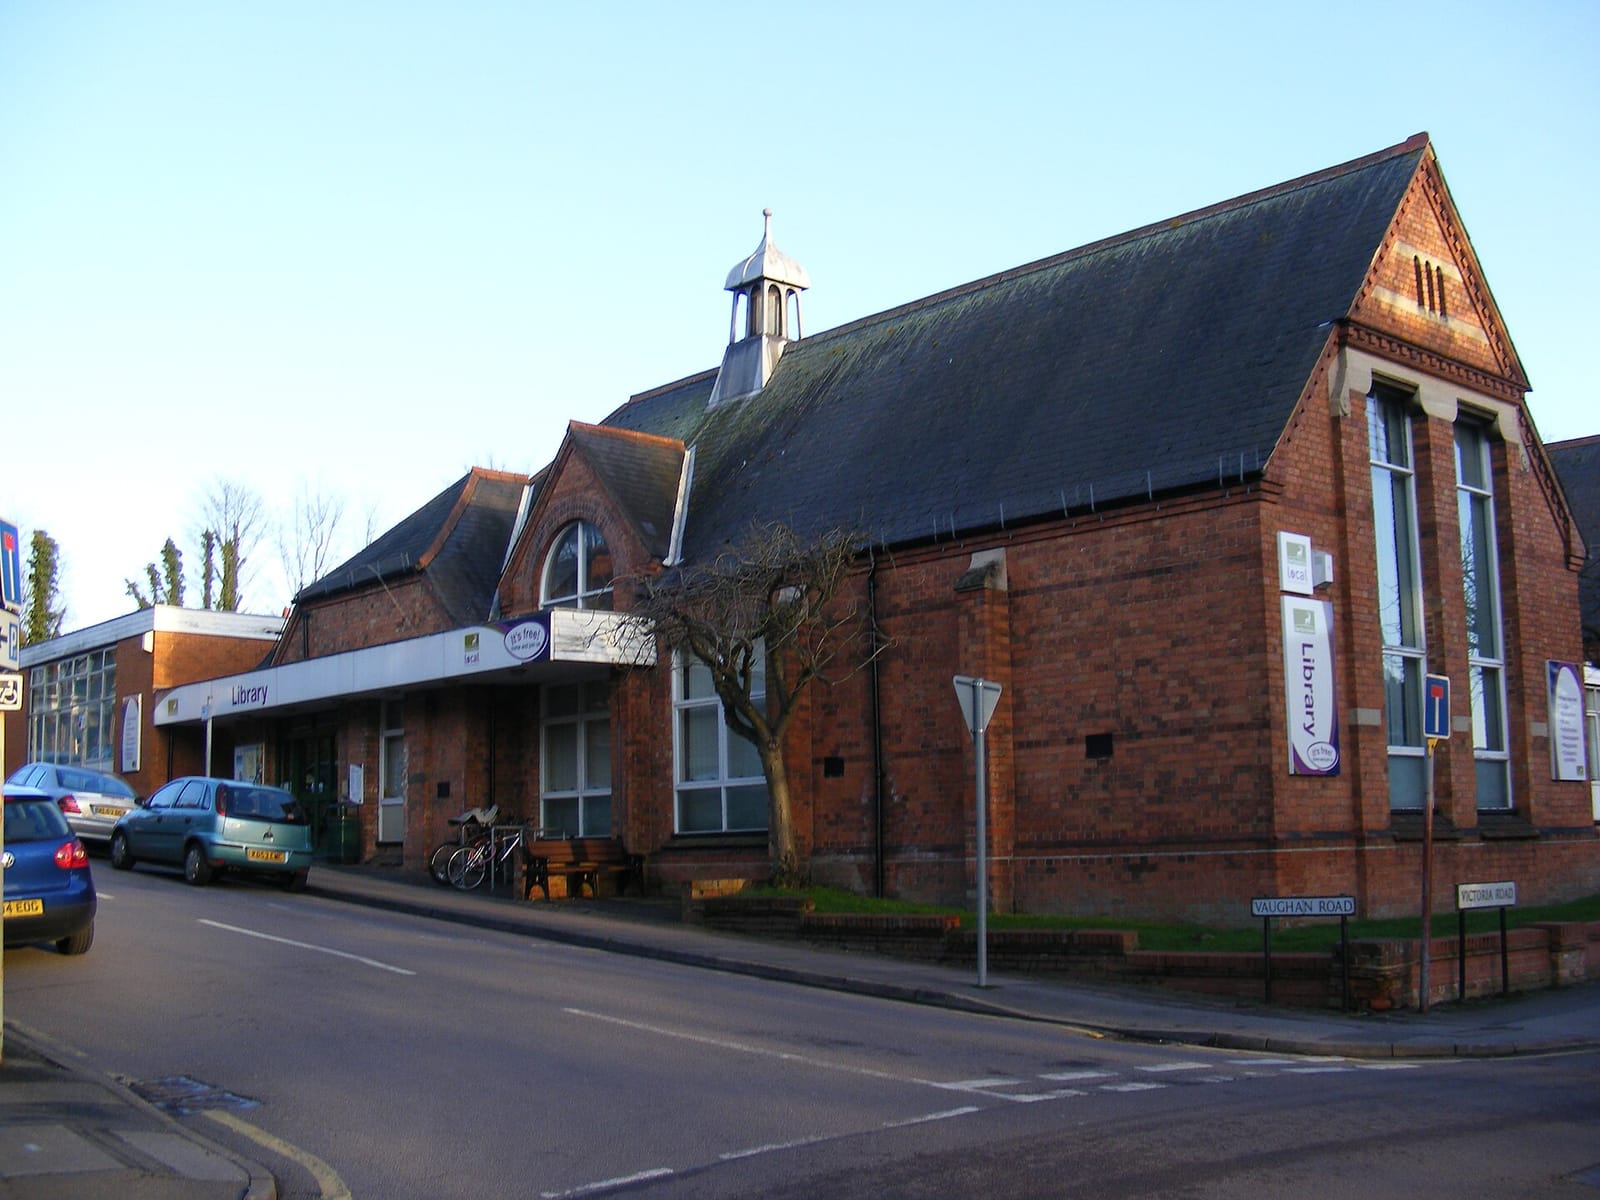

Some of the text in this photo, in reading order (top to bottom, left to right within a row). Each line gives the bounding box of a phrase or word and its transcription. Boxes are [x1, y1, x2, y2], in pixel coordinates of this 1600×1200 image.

[1287, 565, 1308, 581] local
[232, 684, 268, 705] Library
[1302, 643, 1315, 737] Library
[1461, 887, 1513, 902] VICTORIA ROAD
[1255, 899, 1353, 913] VAUGHAN ROAD
